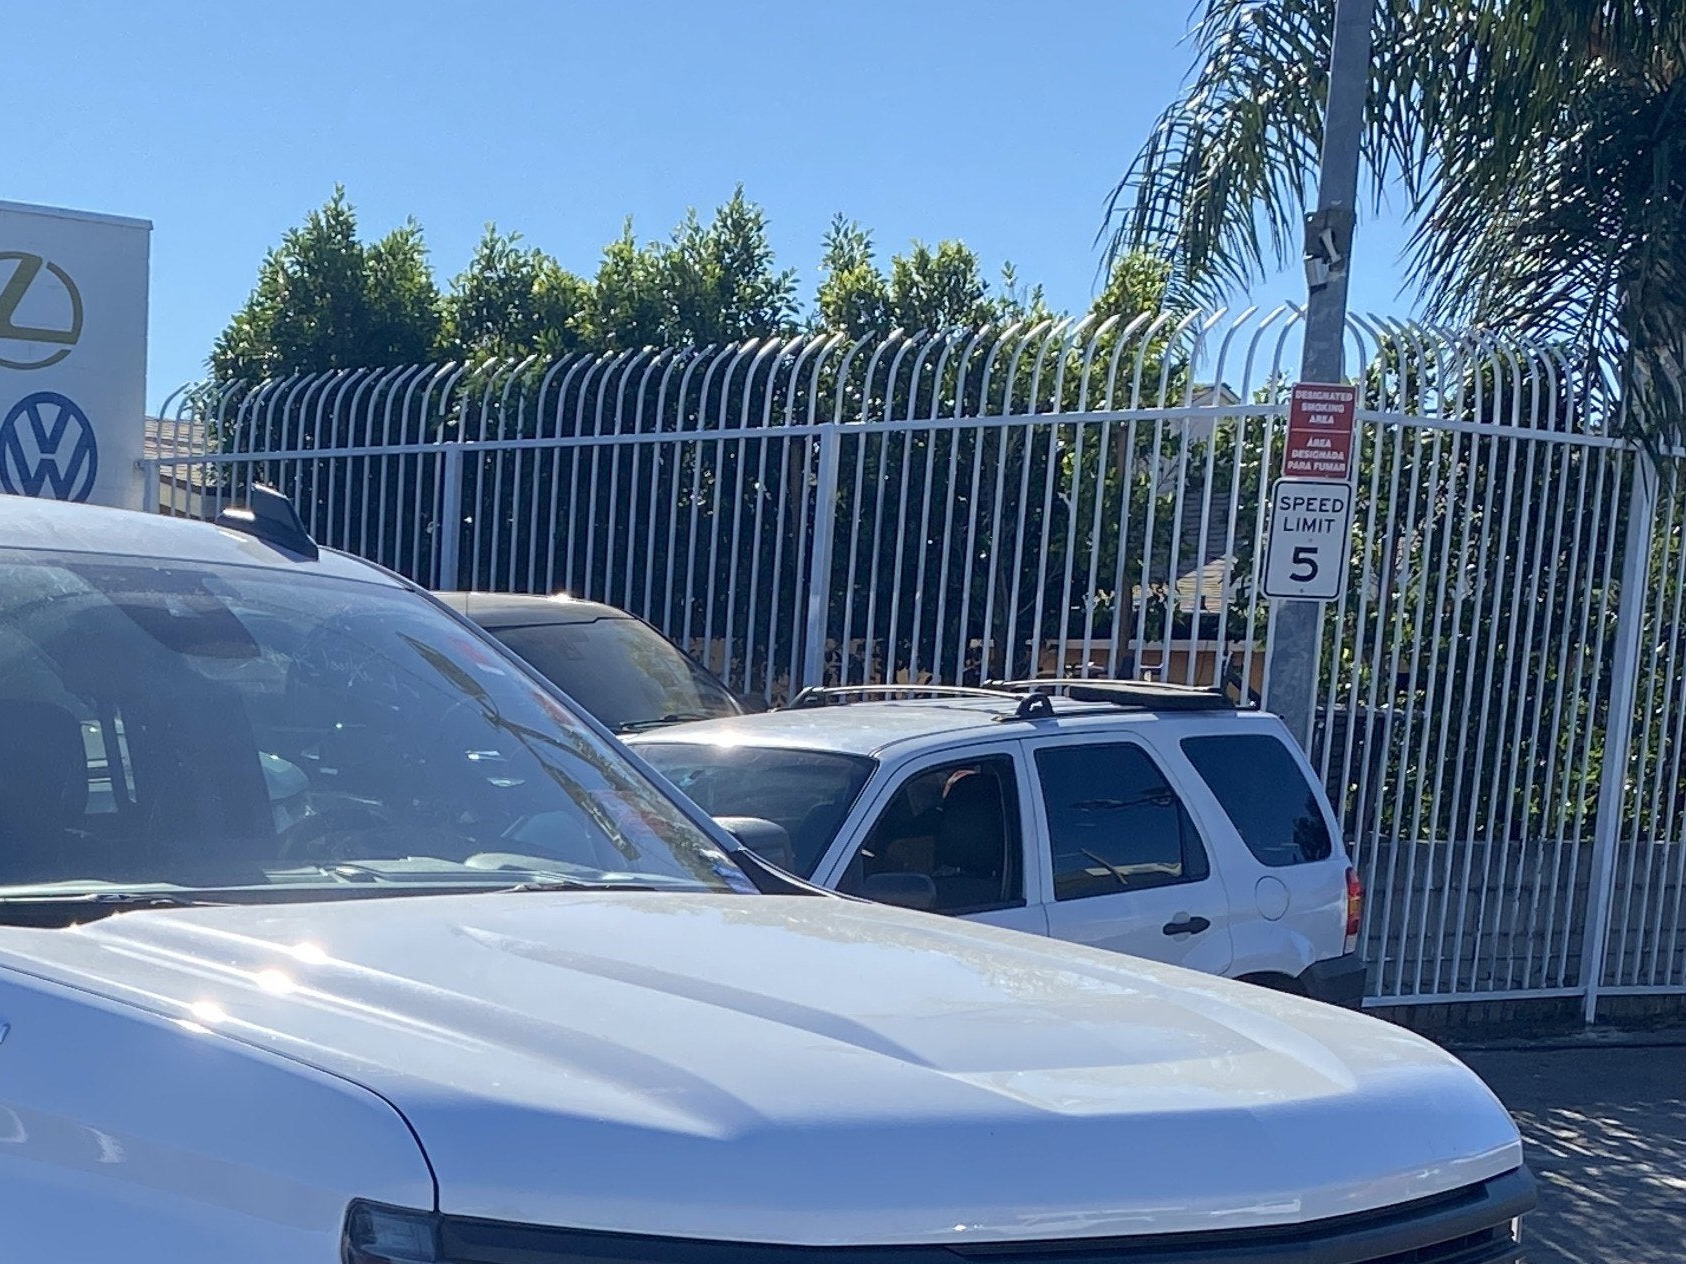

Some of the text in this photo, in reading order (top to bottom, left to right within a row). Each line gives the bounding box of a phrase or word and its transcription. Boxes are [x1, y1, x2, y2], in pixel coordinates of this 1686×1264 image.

[1309, 414, 1334, 424] AREA
[1291, 449, 1344, 460] DESIGNADA
[1287, 461, 1311, 470] PARA
[1279, 496, 1344, 513] SPEED
[1283, 516, 1335, 534] LIMIT
[1289, 546, 1318, 582] 5
